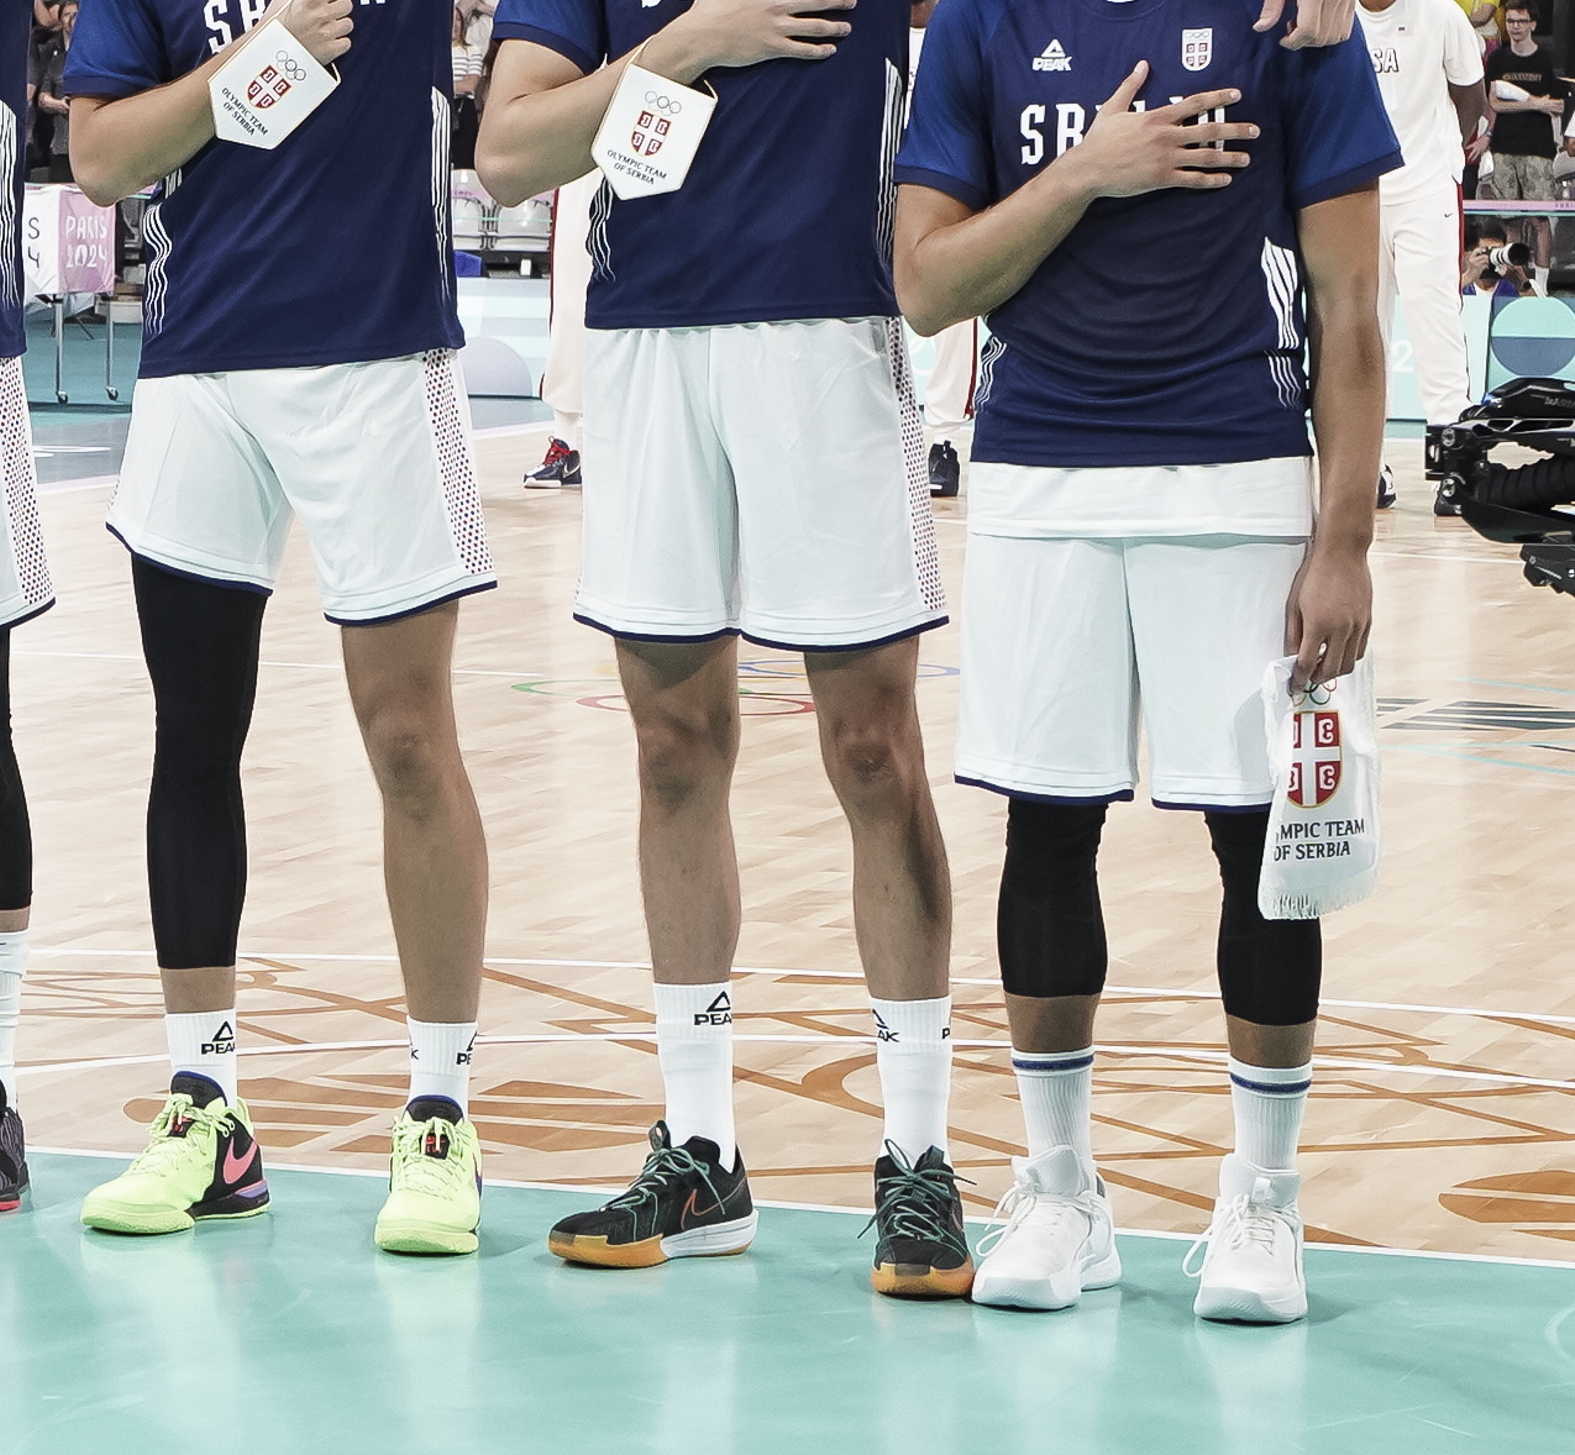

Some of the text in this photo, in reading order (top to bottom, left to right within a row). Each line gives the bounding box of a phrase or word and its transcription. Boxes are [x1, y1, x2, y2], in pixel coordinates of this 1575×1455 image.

[1369, 48, 1400, 73] SA
[221, 87, 268, 136] OLYMPIC TEAM
[232, 110, 255, 136] SERBIA
[606, 149, 667, 181] OLYMPIC TEAM
[614, 162, 655, 185] OF SERBIA
[65, 215, 109, 239] PARIS
[65, 243, 109, 269] 2024
[1275, 818, 1365, 841] MPIC TEAM
[1274, 840, 1351, 861] OF SERBIA
[694, 1012, 732, 1027] PEA
[201, 1042, 235, 1057] PEA
